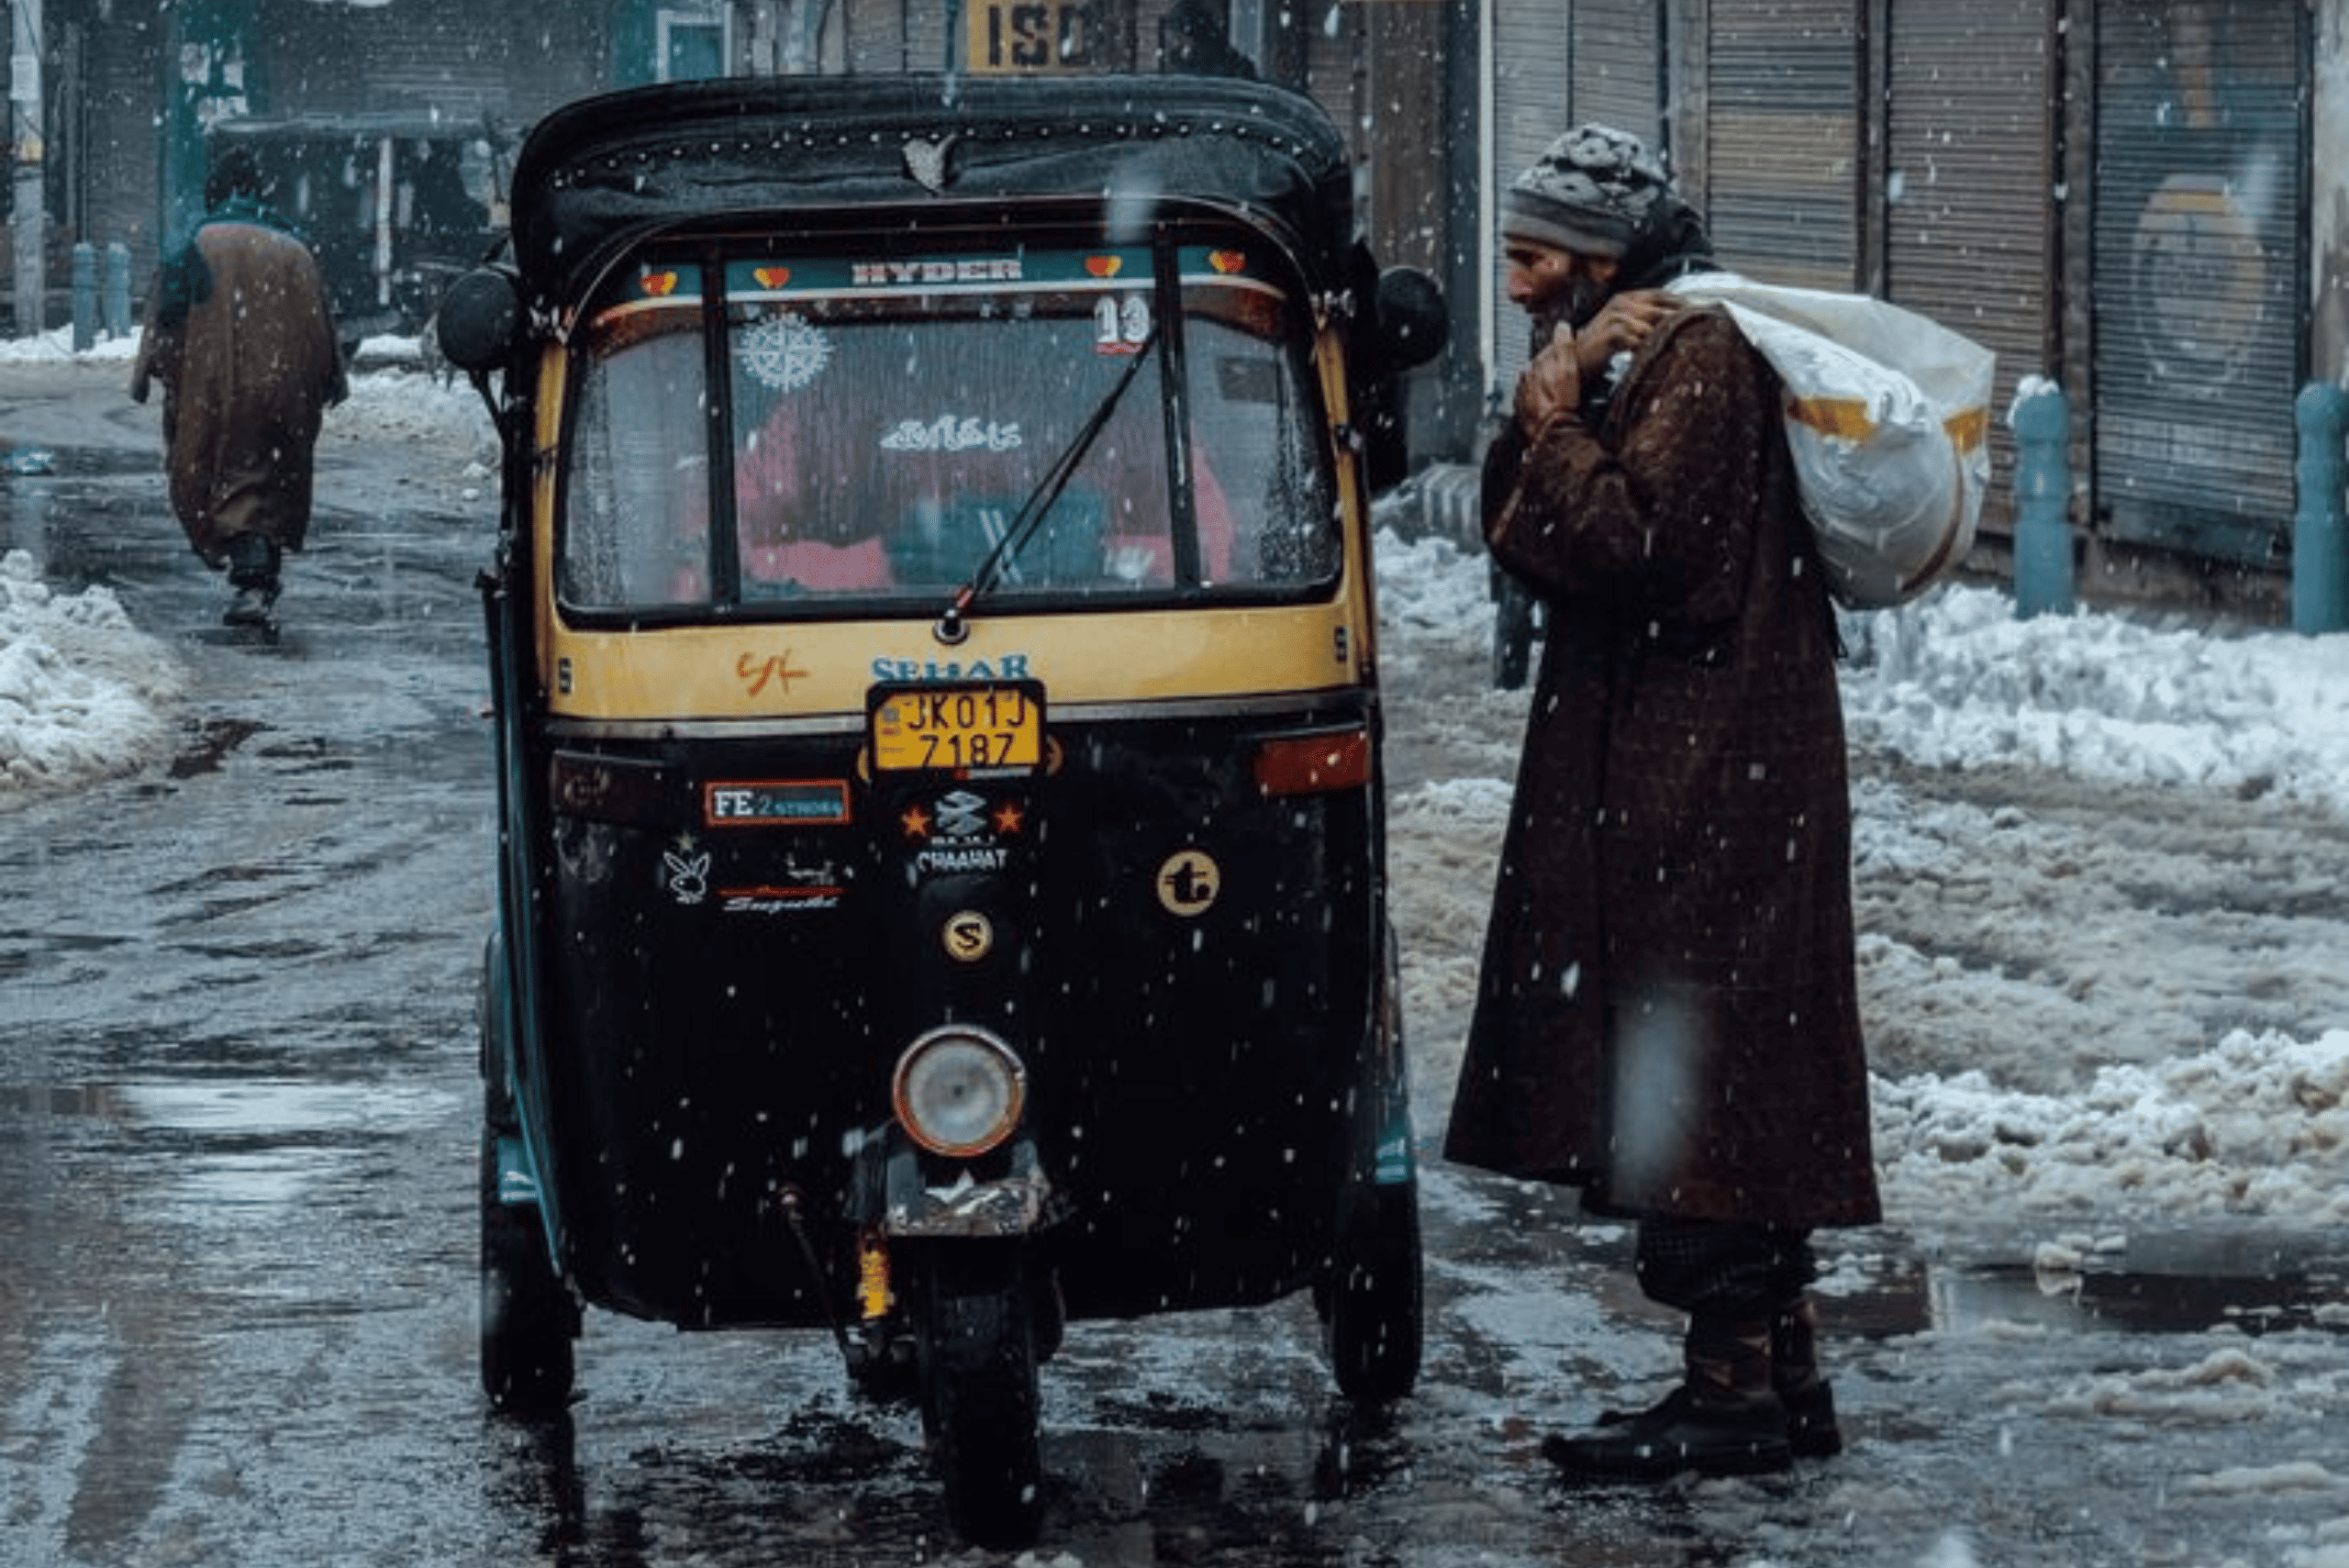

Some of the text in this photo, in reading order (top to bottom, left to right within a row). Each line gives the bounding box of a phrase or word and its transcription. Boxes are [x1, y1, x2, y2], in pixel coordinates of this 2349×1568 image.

[852, 259, 1022, 285] HYDER
[918, 733, 1016, 769] 7187
[714, 790, 753, 817] FE
[954, 922, 981, 951] S
